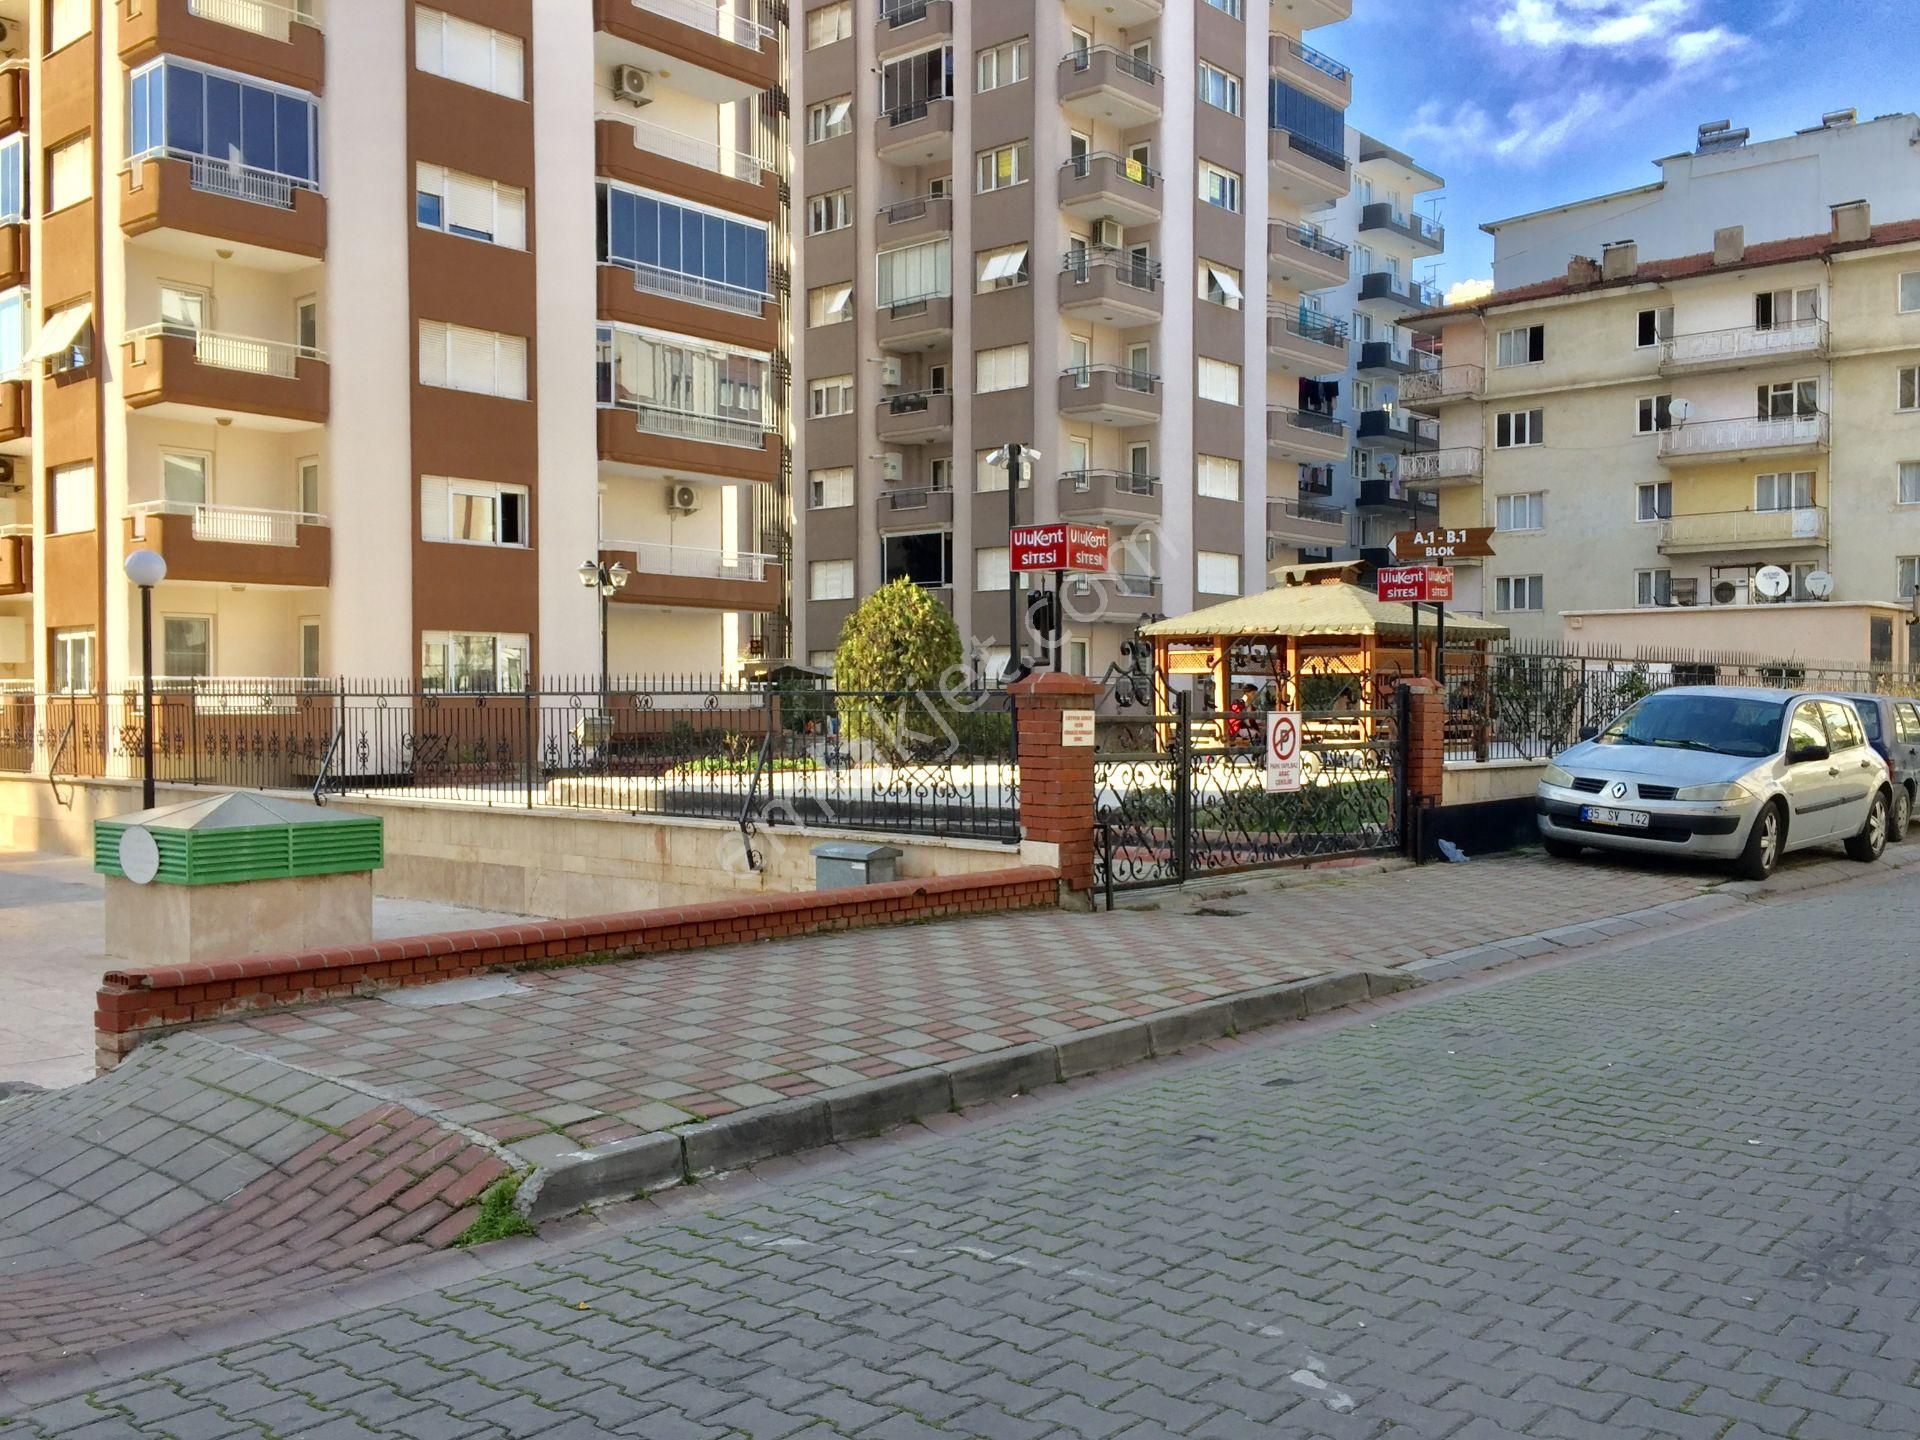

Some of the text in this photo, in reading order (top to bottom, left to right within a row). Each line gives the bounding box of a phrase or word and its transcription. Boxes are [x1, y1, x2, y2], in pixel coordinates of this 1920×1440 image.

[1014, 529, 1064, 546] UluKent
[1070, 529, 1107, 548] UluKent
[1414, 531, 1435, 545] A.1
[1446, 530, 1467, 543] B.1
[1021, 550, 1057, 565] SİTESİ
[1076, 550, 1103, 565] SİTESİ
[1425, 547, 1455, 557] BLOK
[1381, 570, 1424, 584] UluKent
[1387, 587, 1418, 598] SİTESİ
[1588, 808, 1648, 825] 35 SV 142
